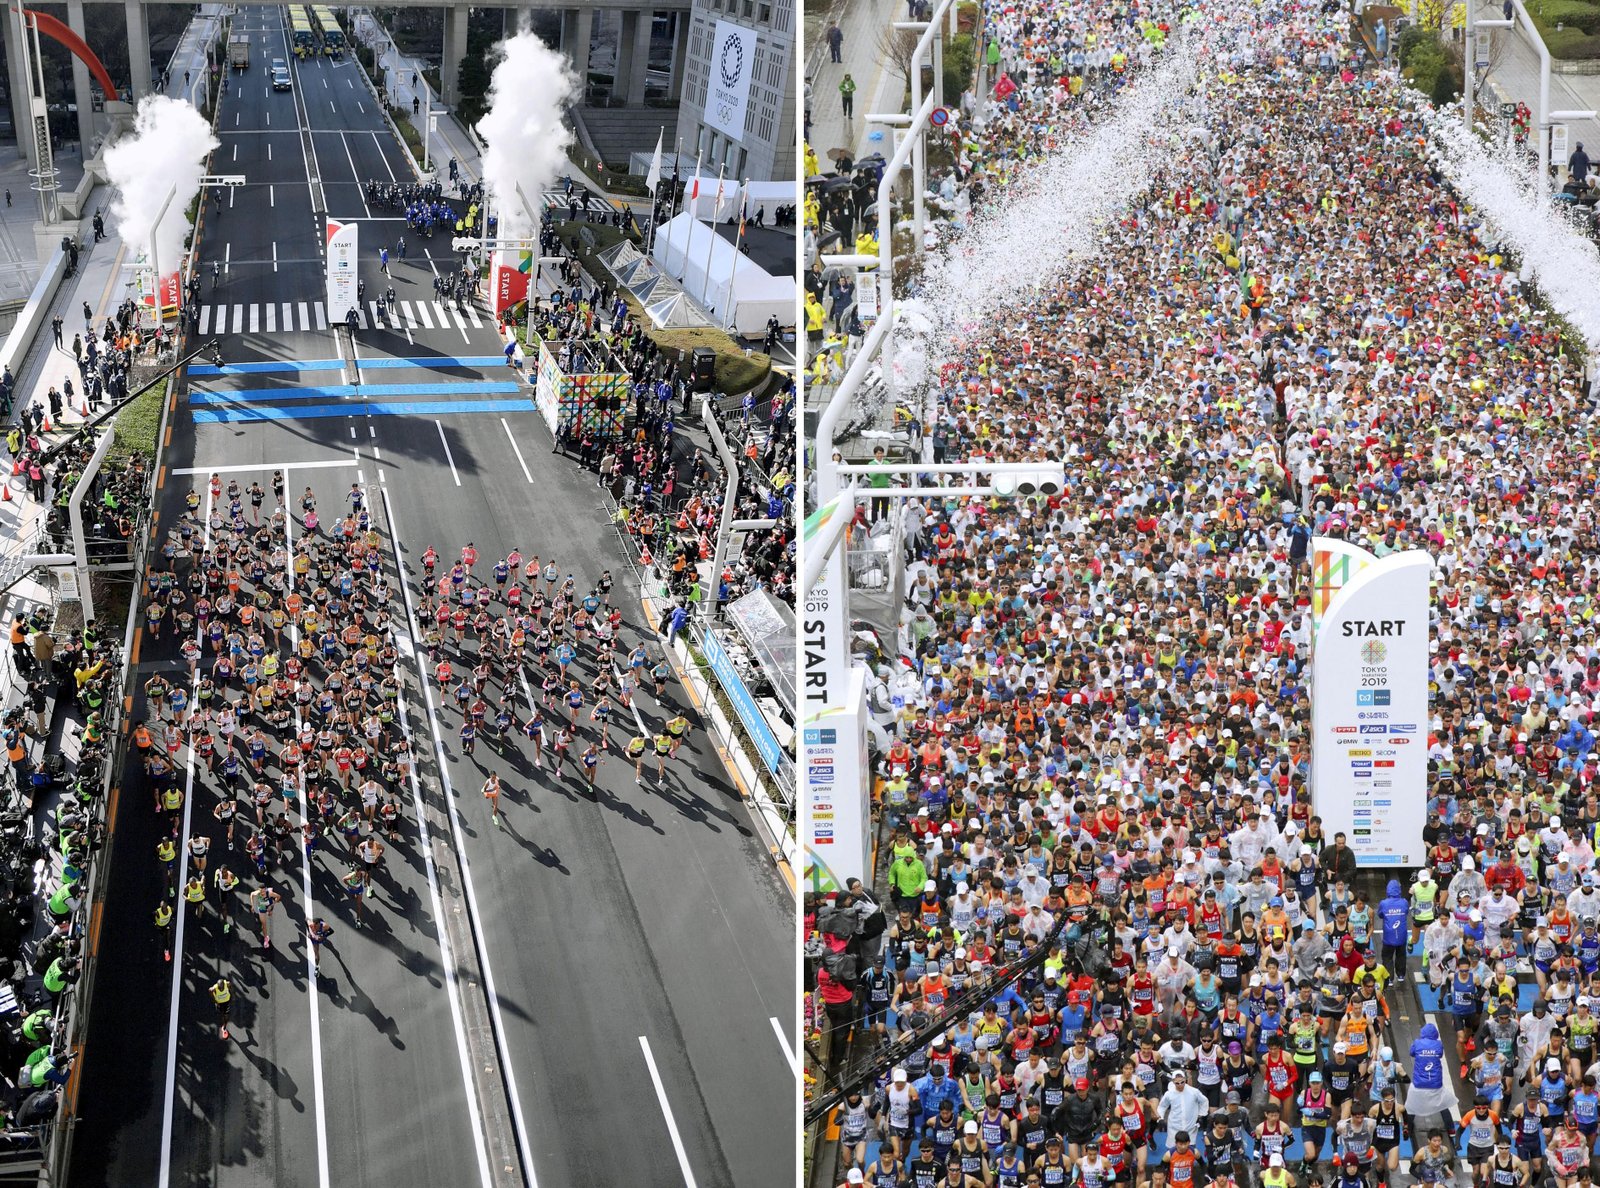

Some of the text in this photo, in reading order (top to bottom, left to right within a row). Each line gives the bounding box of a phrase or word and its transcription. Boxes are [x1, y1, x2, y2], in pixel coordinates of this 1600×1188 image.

[168, 279, 178, 306] START
[501, 272, 510, 300] START
[804, 602, 828, 612] 019
[1342, 620, 1406, 637] START
[804, 620, 828, 704] START
[1361, 678, 1387, 686] 2019
[731, 685, 756, 726] MARATHON
[755, 726, 775, 760] MAJORS
